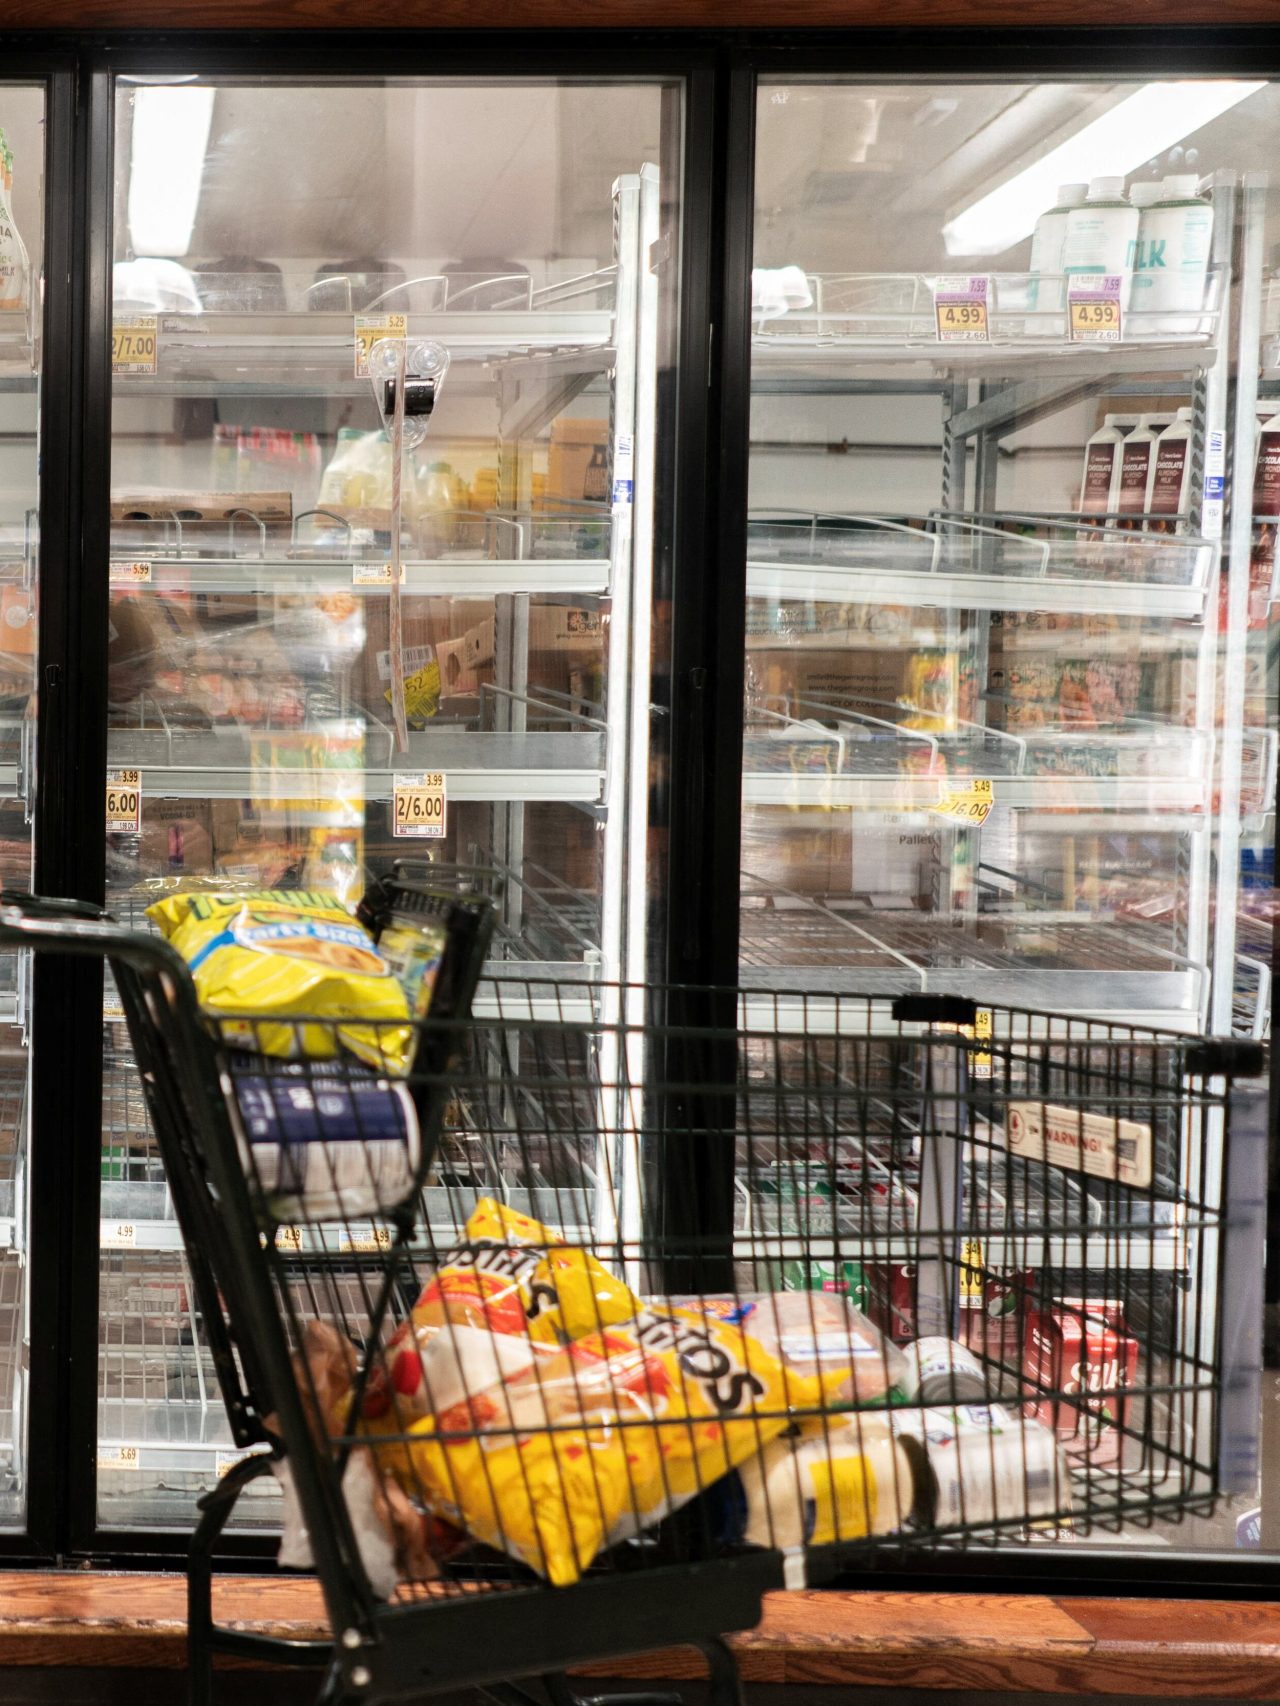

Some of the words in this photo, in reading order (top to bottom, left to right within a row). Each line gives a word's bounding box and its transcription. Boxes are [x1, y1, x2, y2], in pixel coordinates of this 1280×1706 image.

[970, 280, 986, 293] 7.59
[1103, 278, 1120, 291] 7.59
[945, 307, 980, 324] 4.99
[1078, 306, 1113, 323] 4.99
[389, 316, 405, 328] 5.29
[1156, 461, 1184, 470] CHOCOLATE
[132, 563, 149, 575] 5.99
[122, 771, 138, 783] 3.99
[426, 774, 443, 786] 3.99
[974, 780, 990, 792] 5.49
[397, 795, 442, 821] 2/6.00
[1045, 1127, 1102, 1152] WARNNG!
[117, 1226, 133, 1237] 4.99
[1063, 1359, 1132, 1396] Silk
[120, 1448, 136, 1460] 5.69
